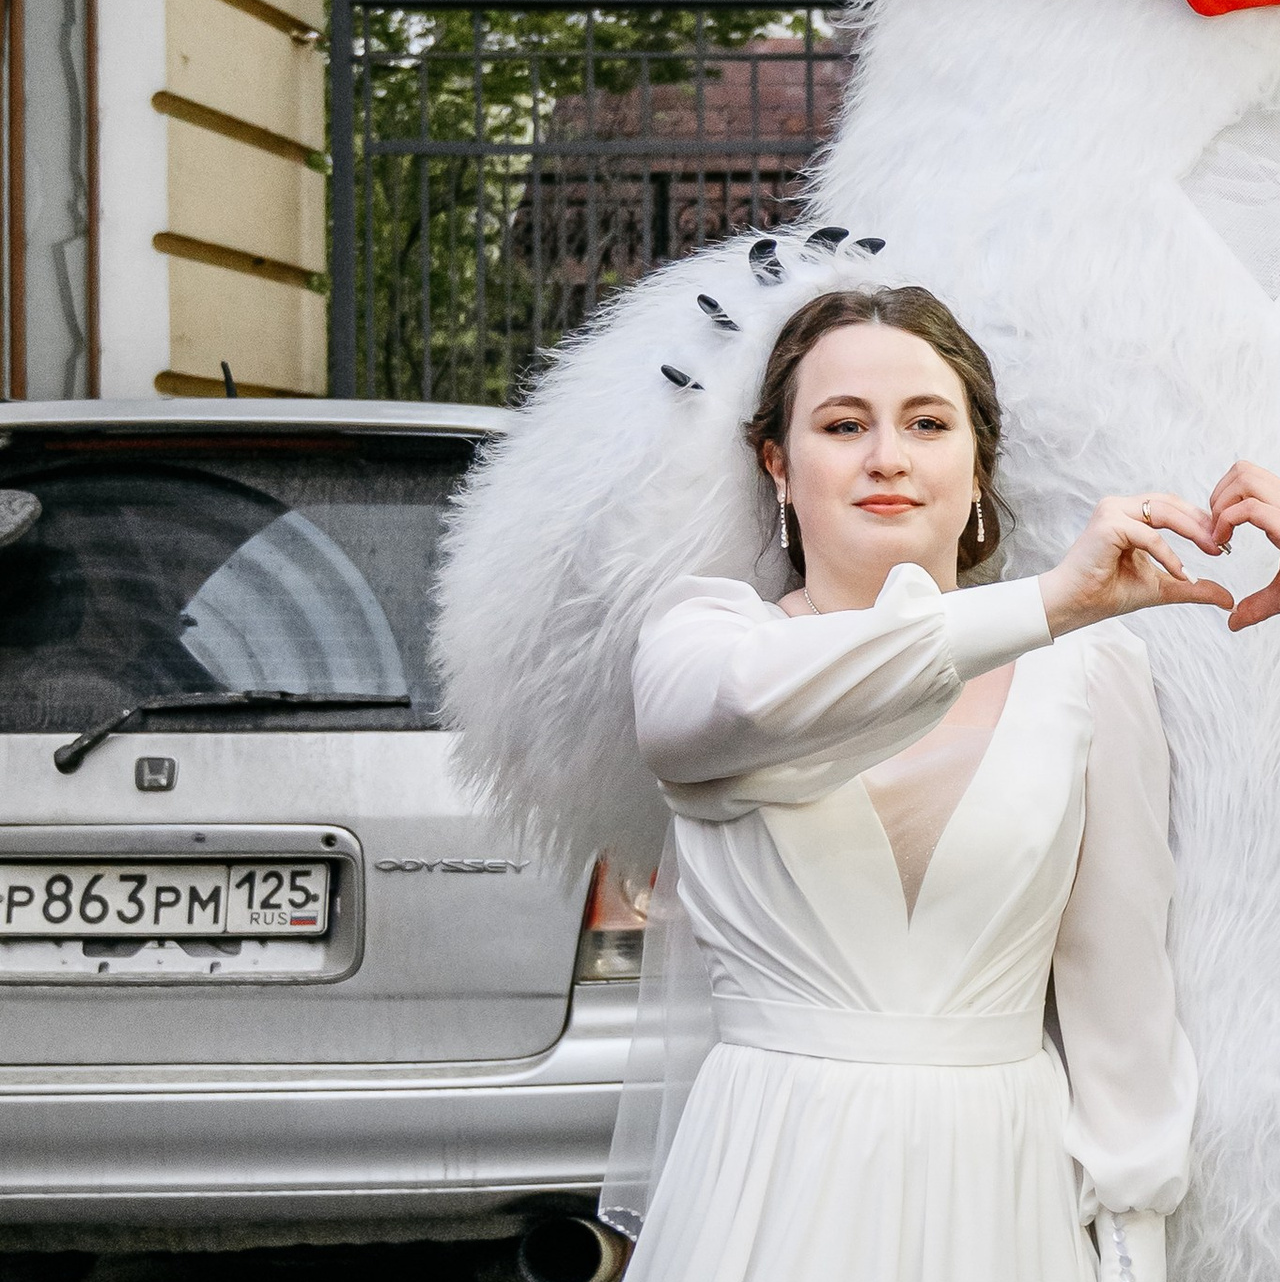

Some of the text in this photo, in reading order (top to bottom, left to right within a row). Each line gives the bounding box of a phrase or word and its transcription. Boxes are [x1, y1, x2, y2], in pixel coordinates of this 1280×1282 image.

[374, 858, 531, 875] ODYSSEY
[235, 869, 312, 910] 125
[249, 911, 289, 926] RUS
